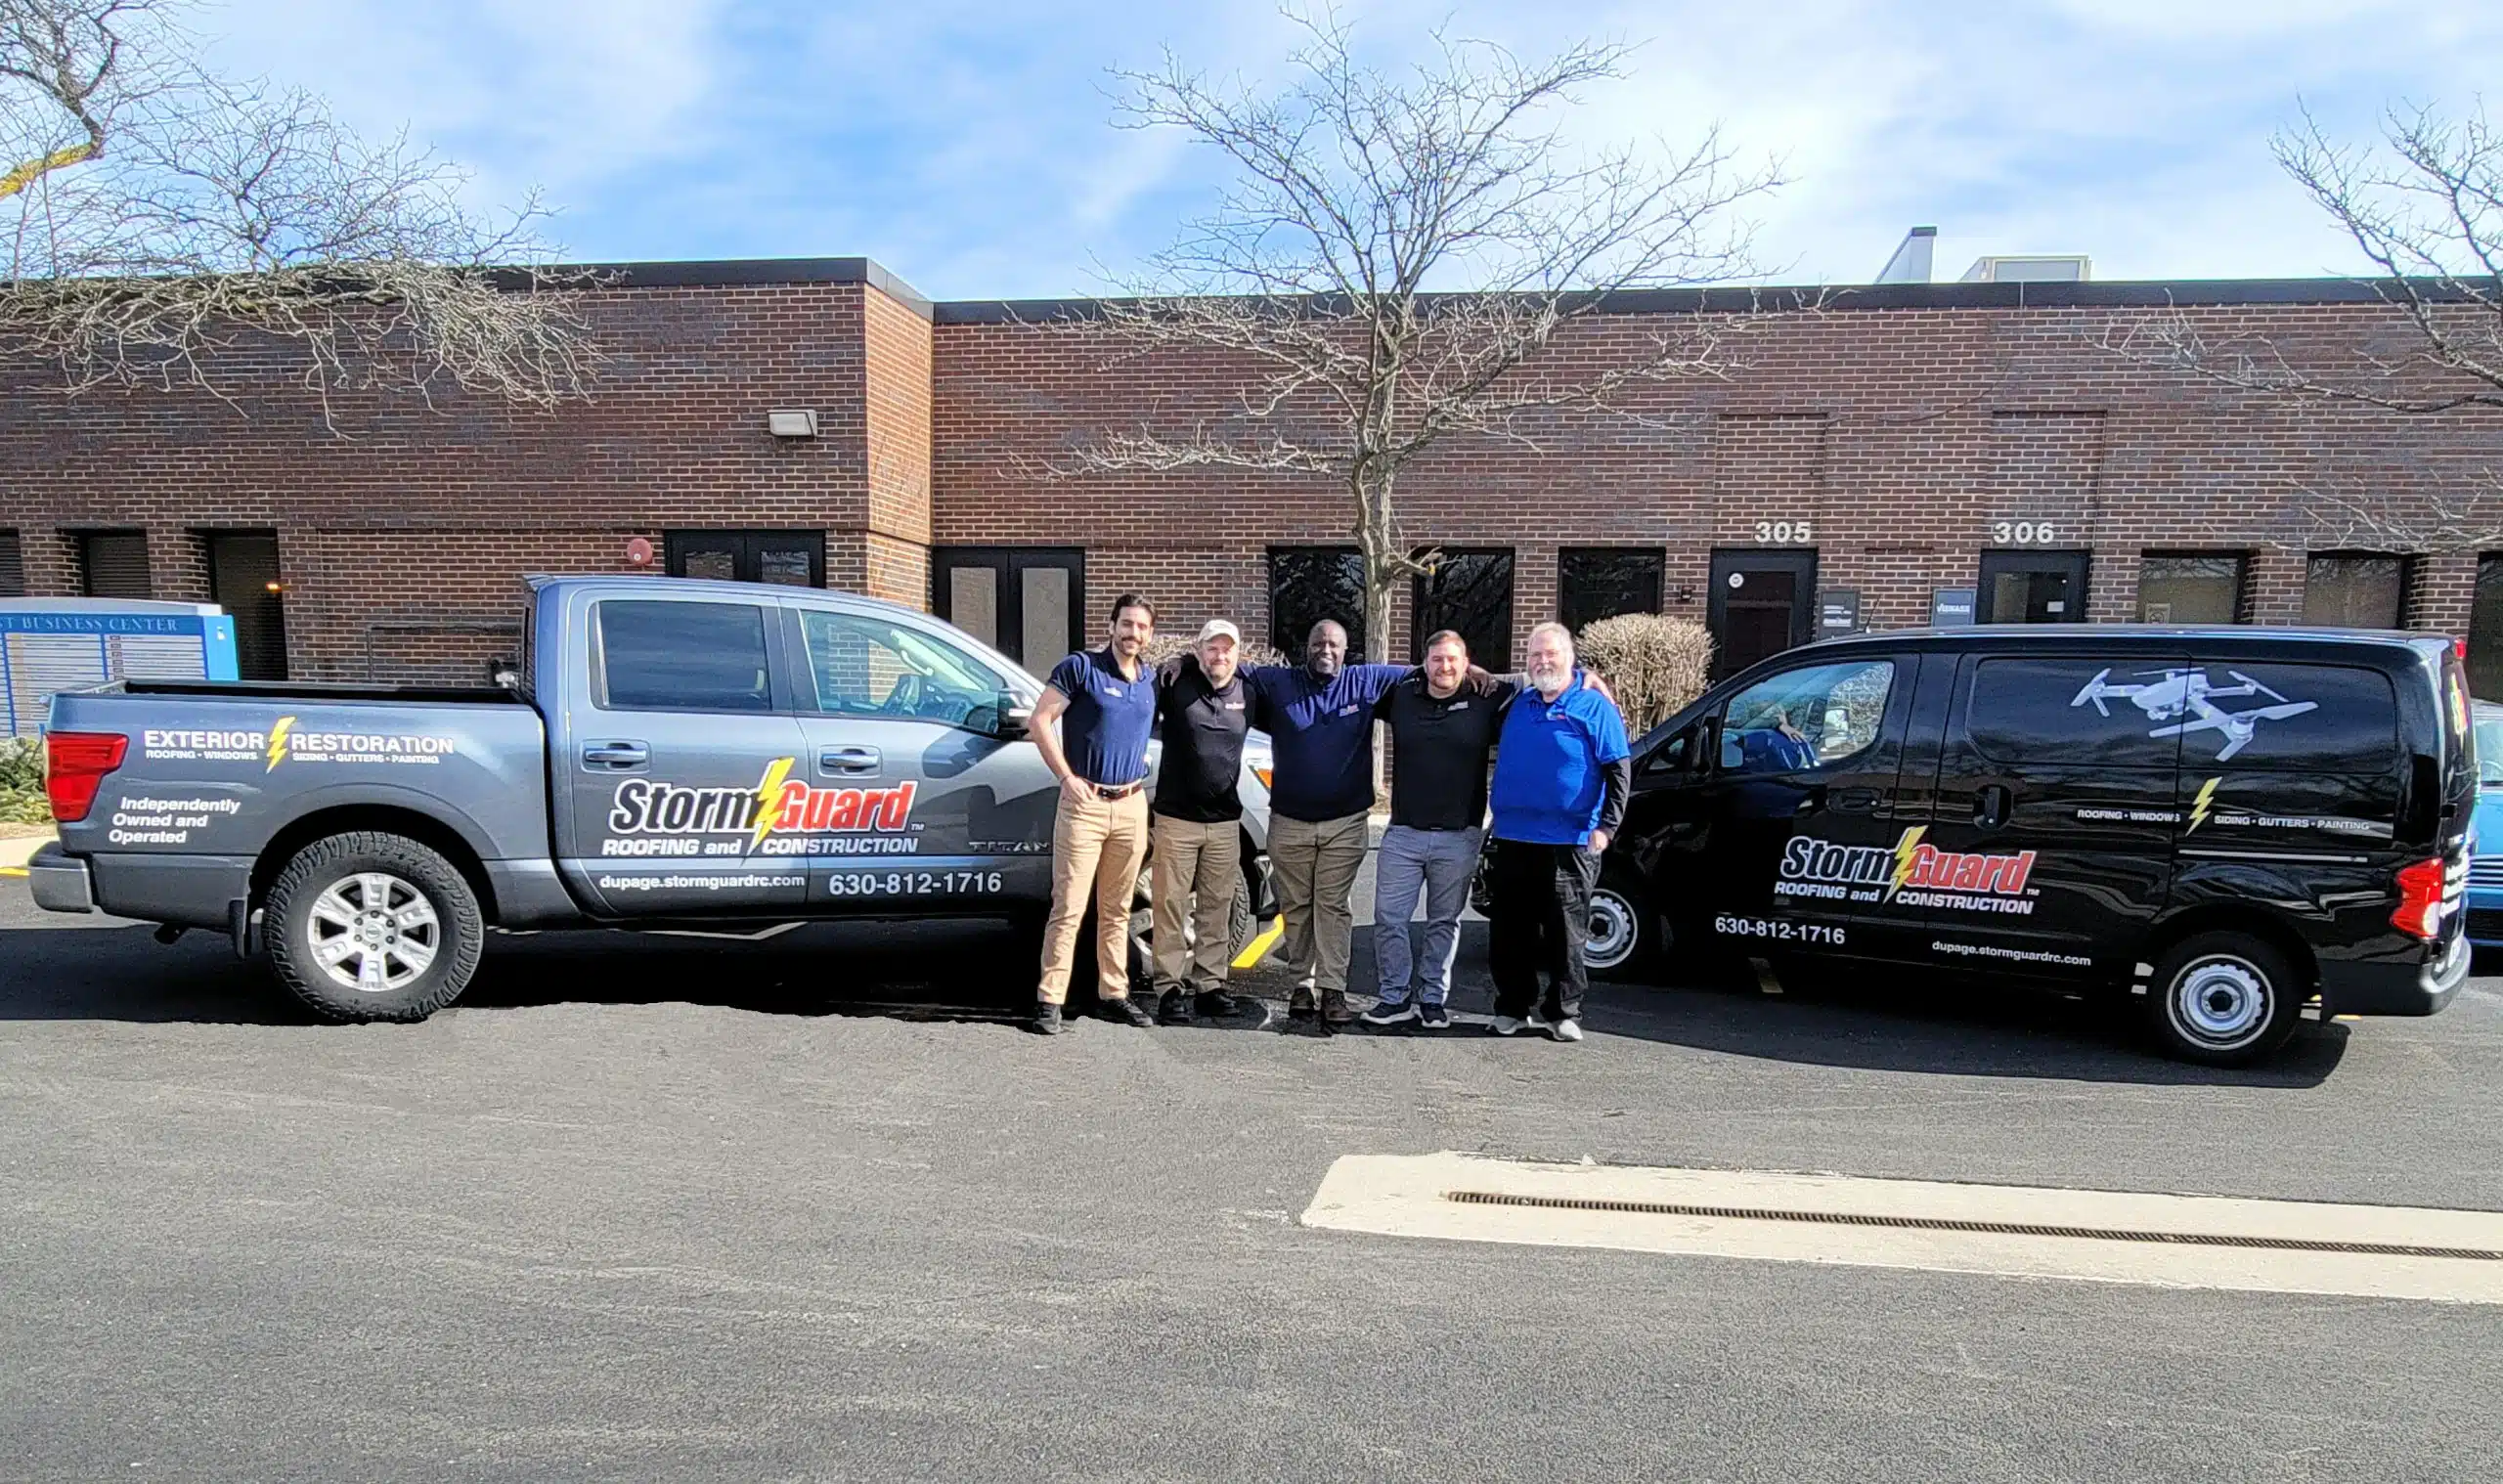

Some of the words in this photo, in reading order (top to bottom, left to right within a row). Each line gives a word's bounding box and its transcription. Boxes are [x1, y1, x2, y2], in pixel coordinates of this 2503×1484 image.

[1754, 522, 1811, 543] 305
[1994, 522, 2054, 544] 306
[22, 617, 102, 629] BUSINESS
[109, 619, 178, 632] CENTER
[144, 730, 264, 750] EXTERIOR
[291, 733, 454, 754] RESTORATION
[146, 750, 196, 760] ROOFING
[203, 751, 258, 761] WINDOWS
[335, 754, 383, 764] GUTTERS
[391, 755, 439, 764] PAINTING
[120, 797, 241, 814] Independently
[608, 778, 759, 833] Storm
[772, 779, 918, 833] Guard
[111, 812, 172, 826] Owned
[175, 814, 208, 827] and
[2078, 809, 2123, 821] ROOFING
[2130, 811, 2180, 822] WINDOWS
[2215, 815, 2250, 825] SIDING
[2259, 817, 2309, 828] GUTTERS
[2316, 819, 2369, 831] PAINTING
[109, 829, 187, 845] Operated
[602, 839, 700, 855] ROOFING
[704, 838, 740, 854] and
[762, 837, 918, 853] CONSTRUCTION
[1779, 836, 1895, 884] Storm
[1905, 843, 2037, 895] Guard
[599, 875, 805, 891] dupage.stormguardrc.com
[829, 872, 1002, 895] 630-812-1716
[1774, 881, 1846, 899] ROOFING
[1850, 889, 1879, 902] and
[1895, 891, 2035, 914] CONSTRUCTION
[1715, 917, 1845, 944] 630-812-1716
[1932, 940, 2091, 966] dupage.stormguardrc.com
